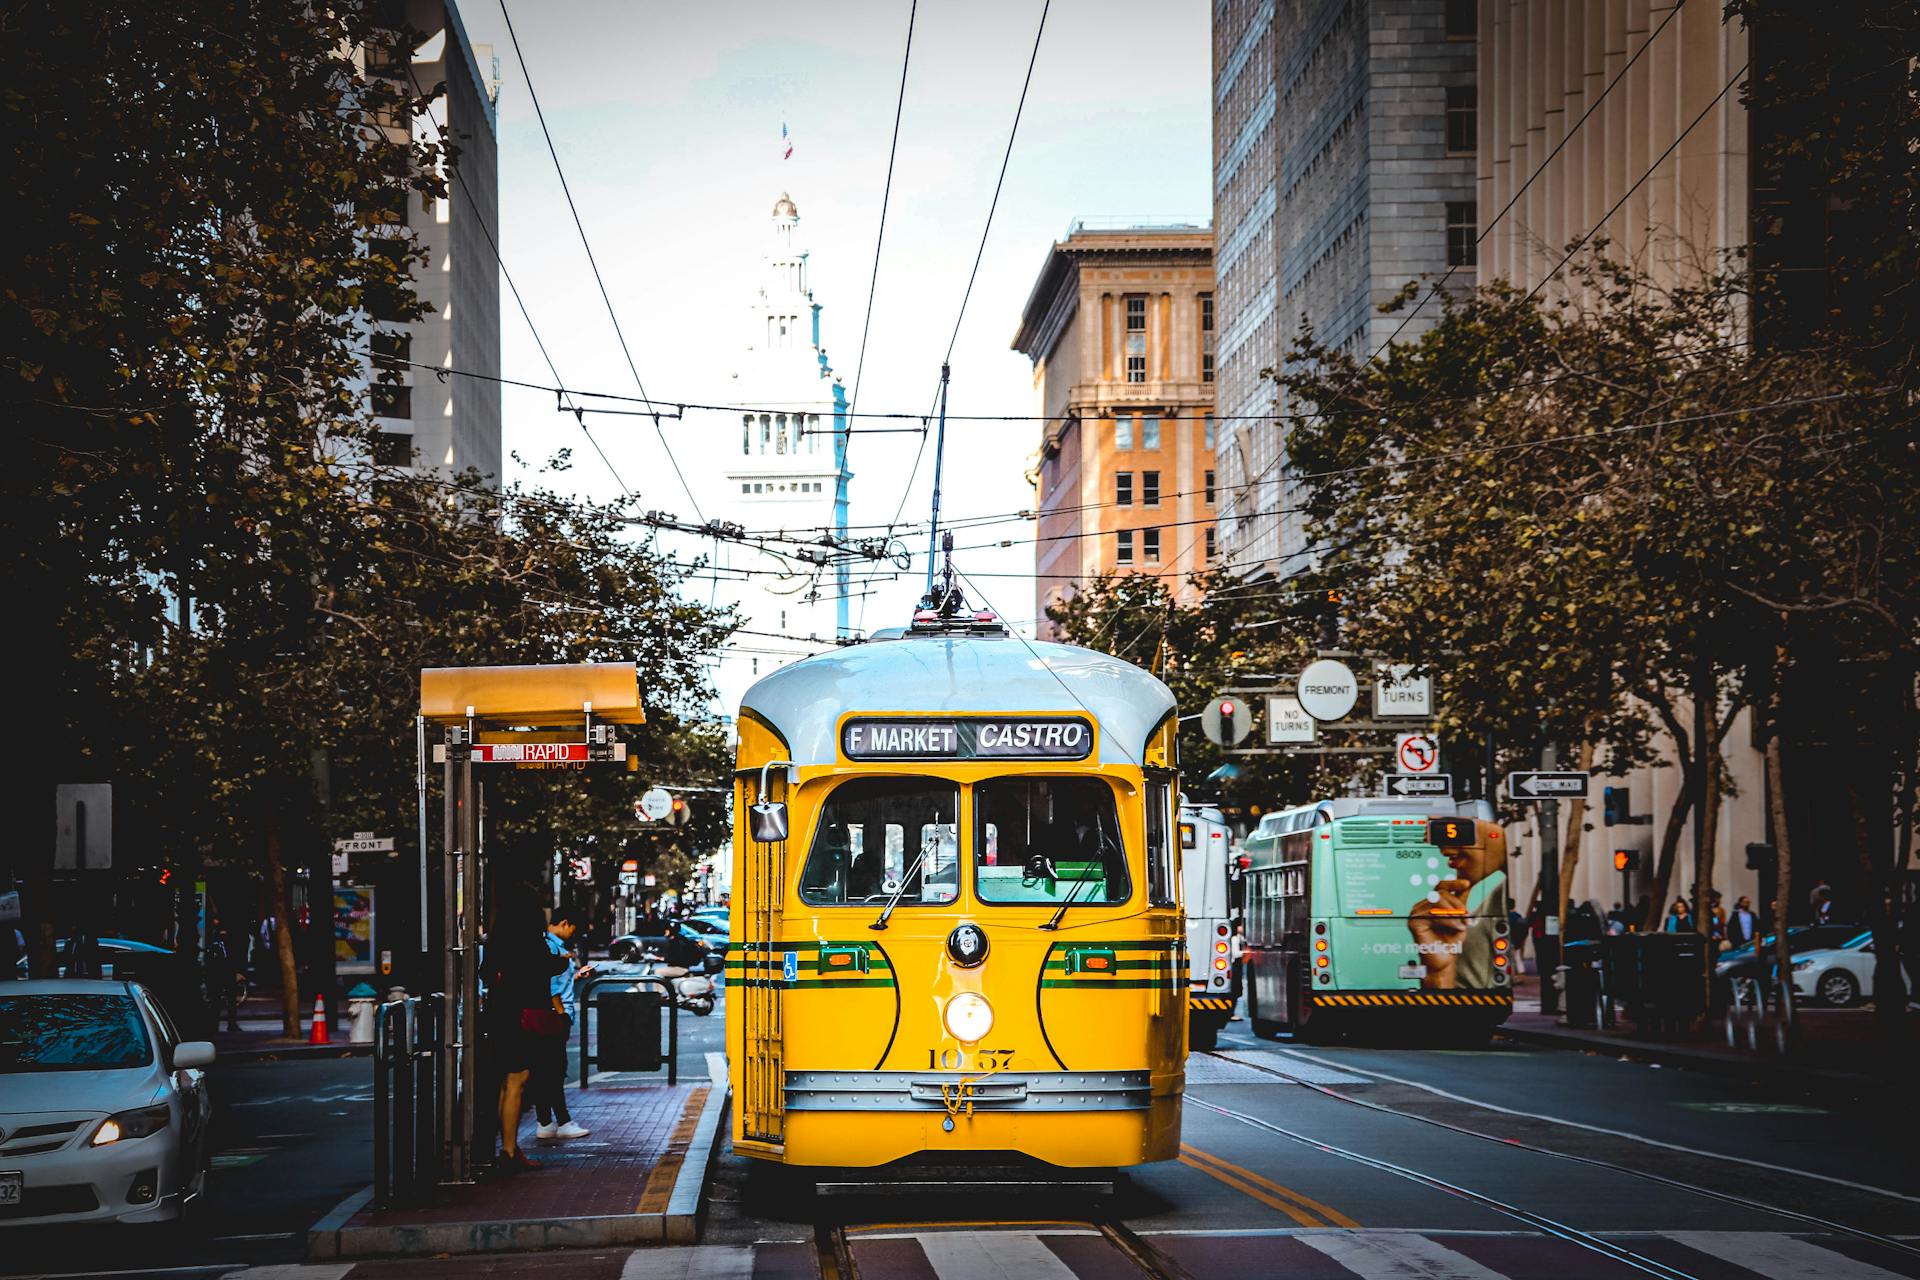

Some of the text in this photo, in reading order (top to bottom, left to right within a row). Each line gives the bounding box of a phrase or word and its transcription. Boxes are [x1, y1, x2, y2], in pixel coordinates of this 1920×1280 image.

[1304, 685, 1351, 695] FREMONT
[1383, 691, 1425, 703] TURNS
[1284, 710, 1299, 719] NO
[1275, 721, 1310, 732] TURNS
[850, 722, 1082, 752] F MARKET CASTRO
[525, 744, 570, 760] RAPID
[1446, 823, 1457, 839] 5
[345, 840, 383, 850] FRONT
[1372, 940, 1464, 955] one medical
